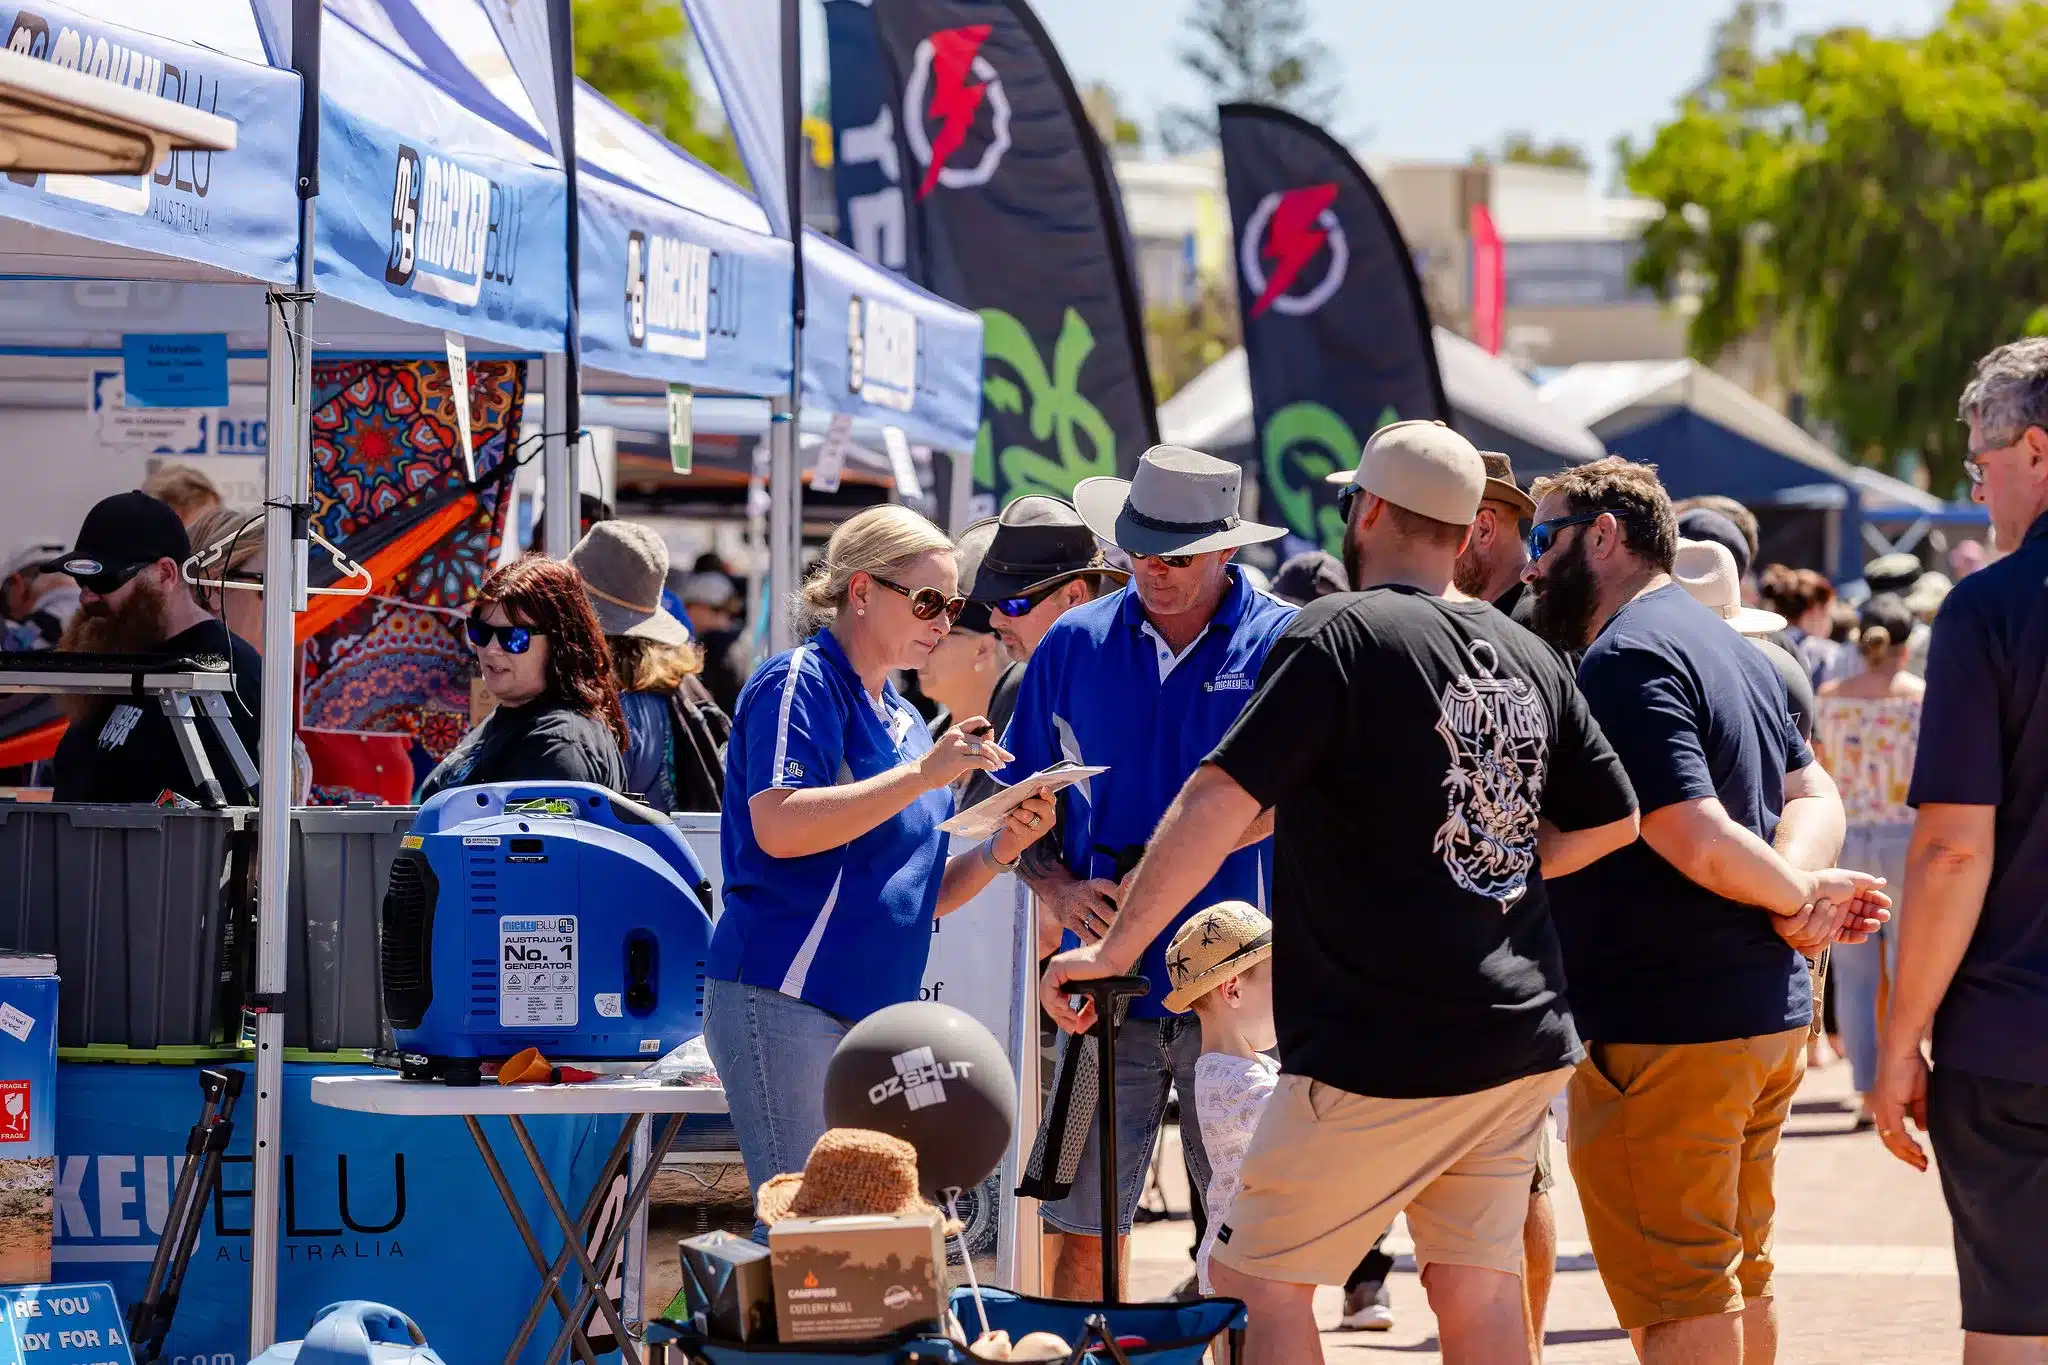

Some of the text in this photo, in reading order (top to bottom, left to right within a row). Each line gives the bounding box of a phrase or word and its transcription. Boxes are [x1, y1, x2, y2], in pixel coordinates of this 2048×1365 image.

[152, 197, 210, 233] AUSTRALIA
[504, 936, 573, 944] AUSTRALIA'S
[504, 944, 573, 961] No. 1
[504, 962, 572, 970] GENERATOR
[868, 1061, 975, 1105] OZSHUT
[216, 1241, 404, 1263] AUTRALIA
[48, 1296, 90, 1316] YOU
[58, 1329, 101, 1348] FOR
[108, 1328, 123, 1346] A
